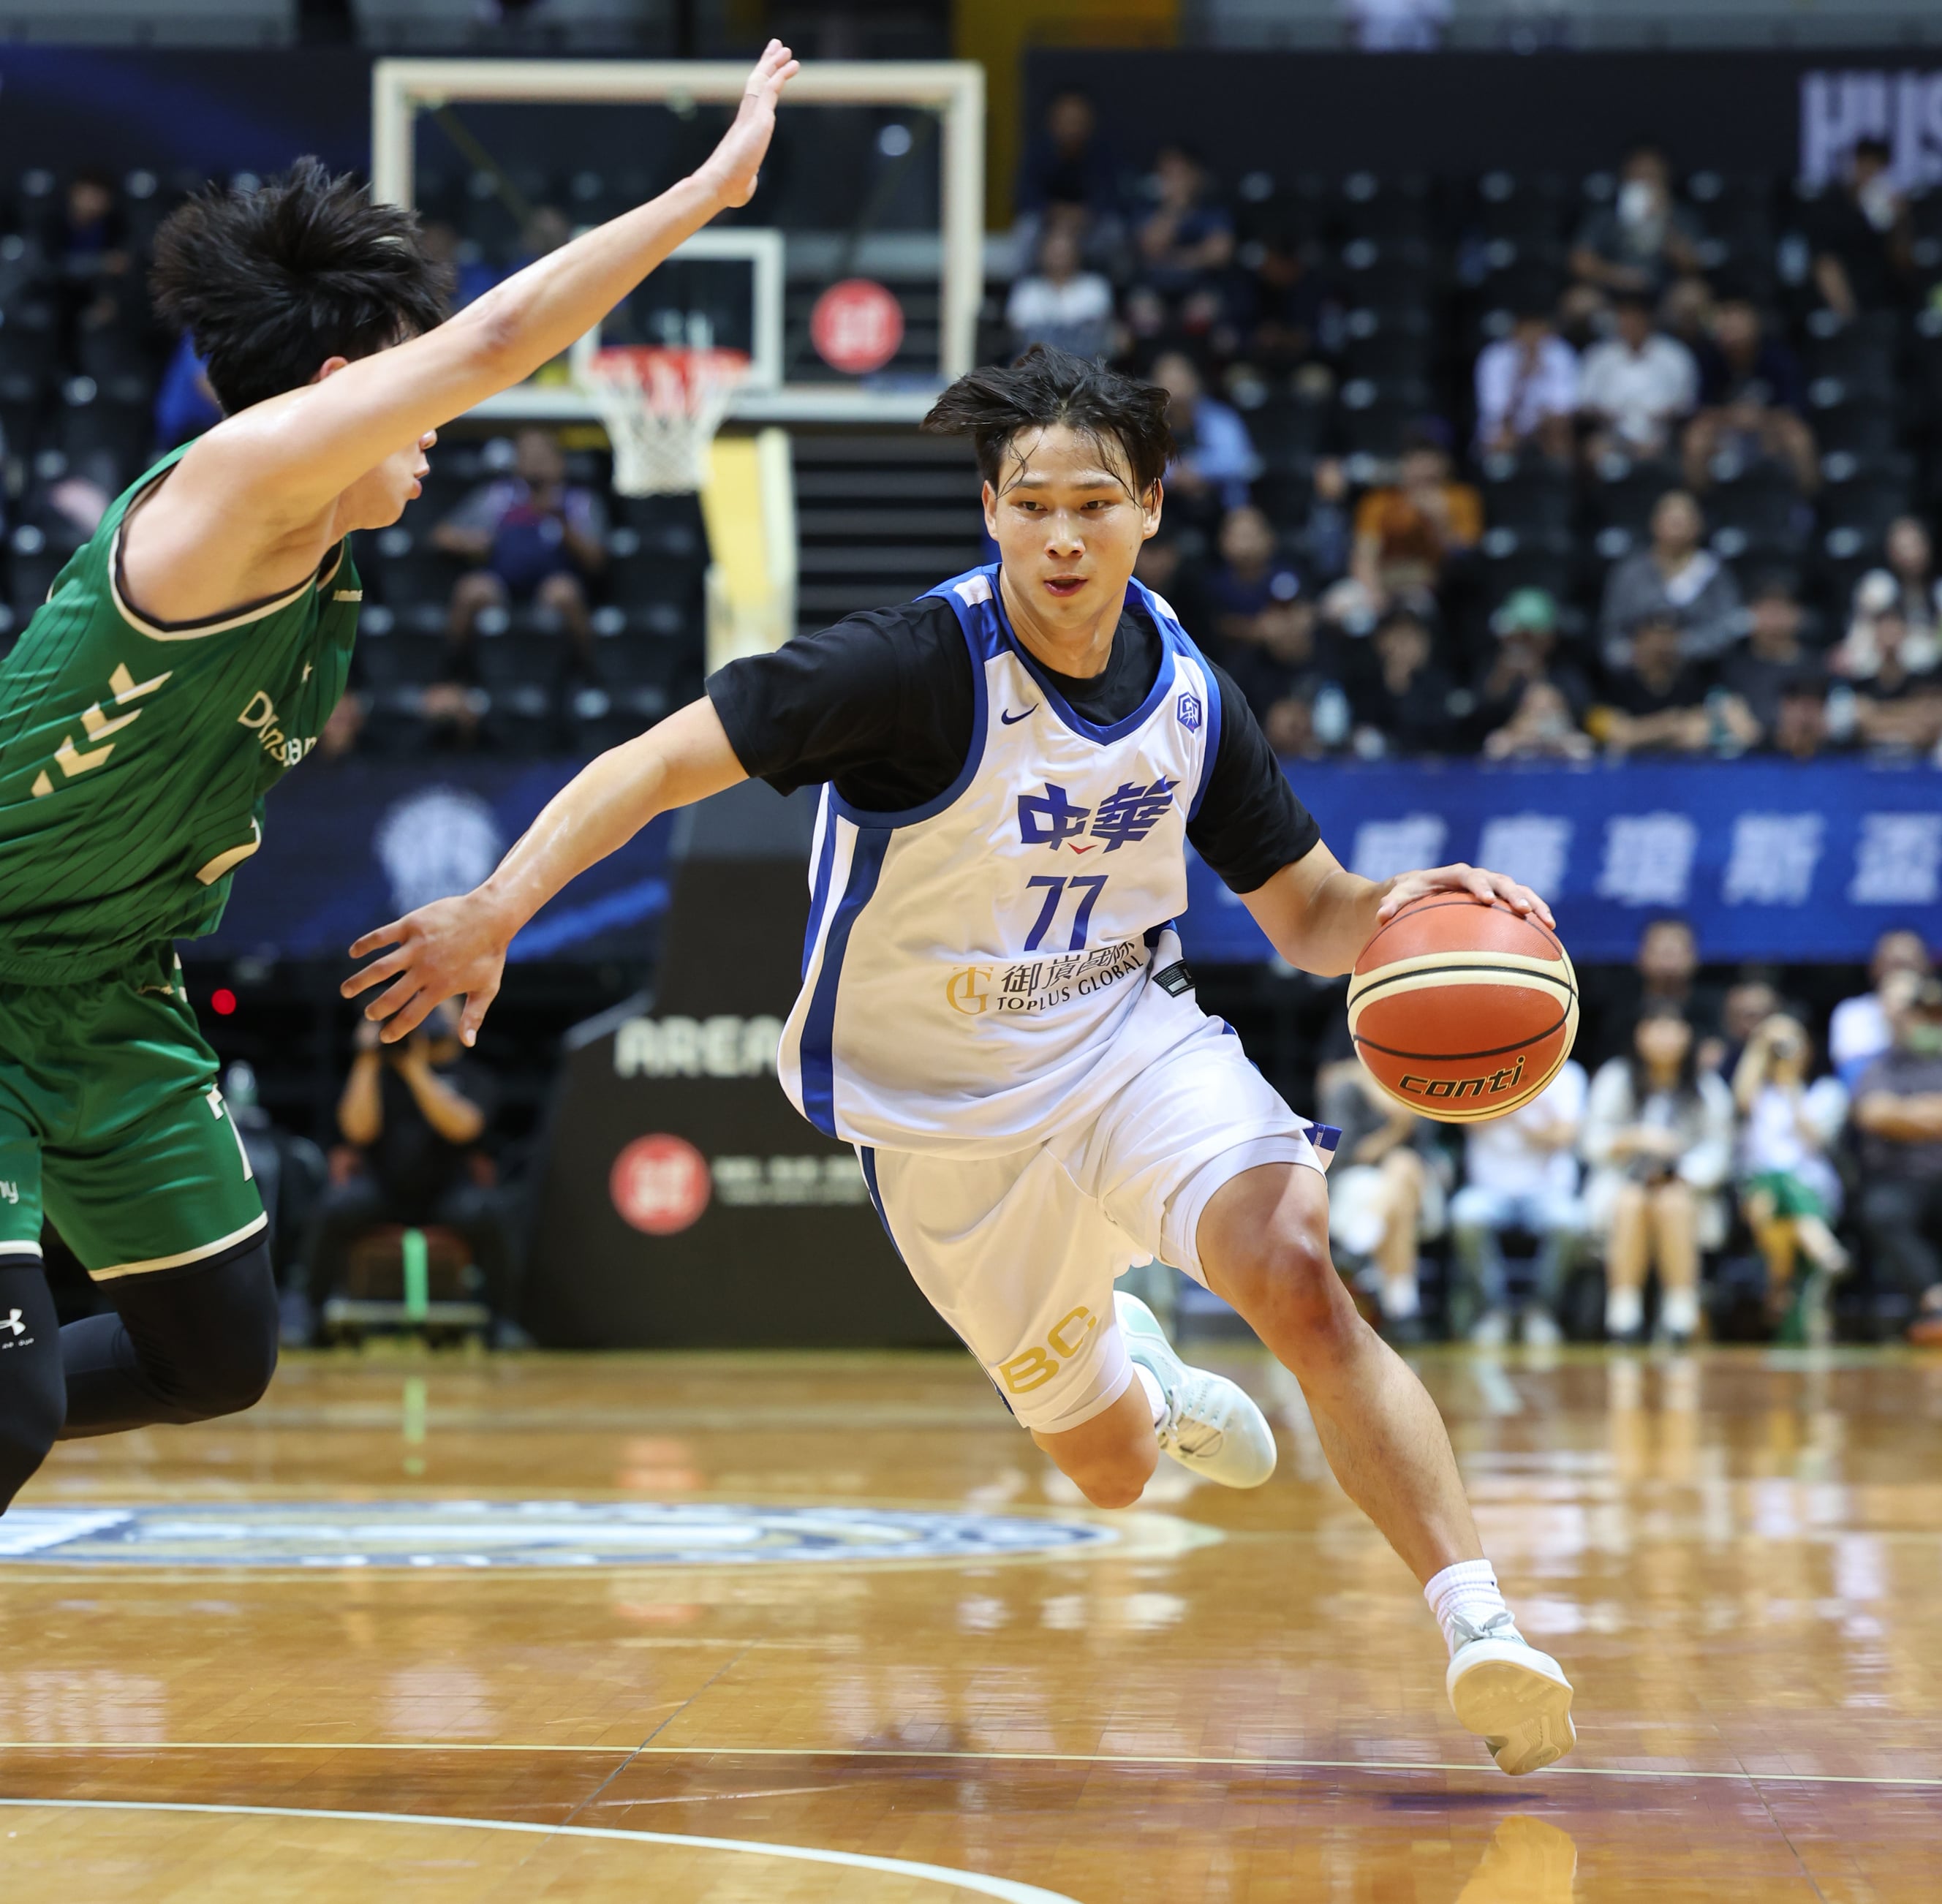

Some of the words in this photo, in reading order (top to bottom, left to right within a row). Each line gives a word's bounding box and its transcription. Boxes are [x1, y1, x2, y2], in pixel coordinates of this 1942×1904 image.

[1017, 774, 1182, 854] 中華
[1024, 875, 1109, 951] 77
[997, 986, 1071, 1010] TOPLUS
[1078, 955, 1144, 996] GLOBAL
[1398, 1055, 1526, 1098] conti
